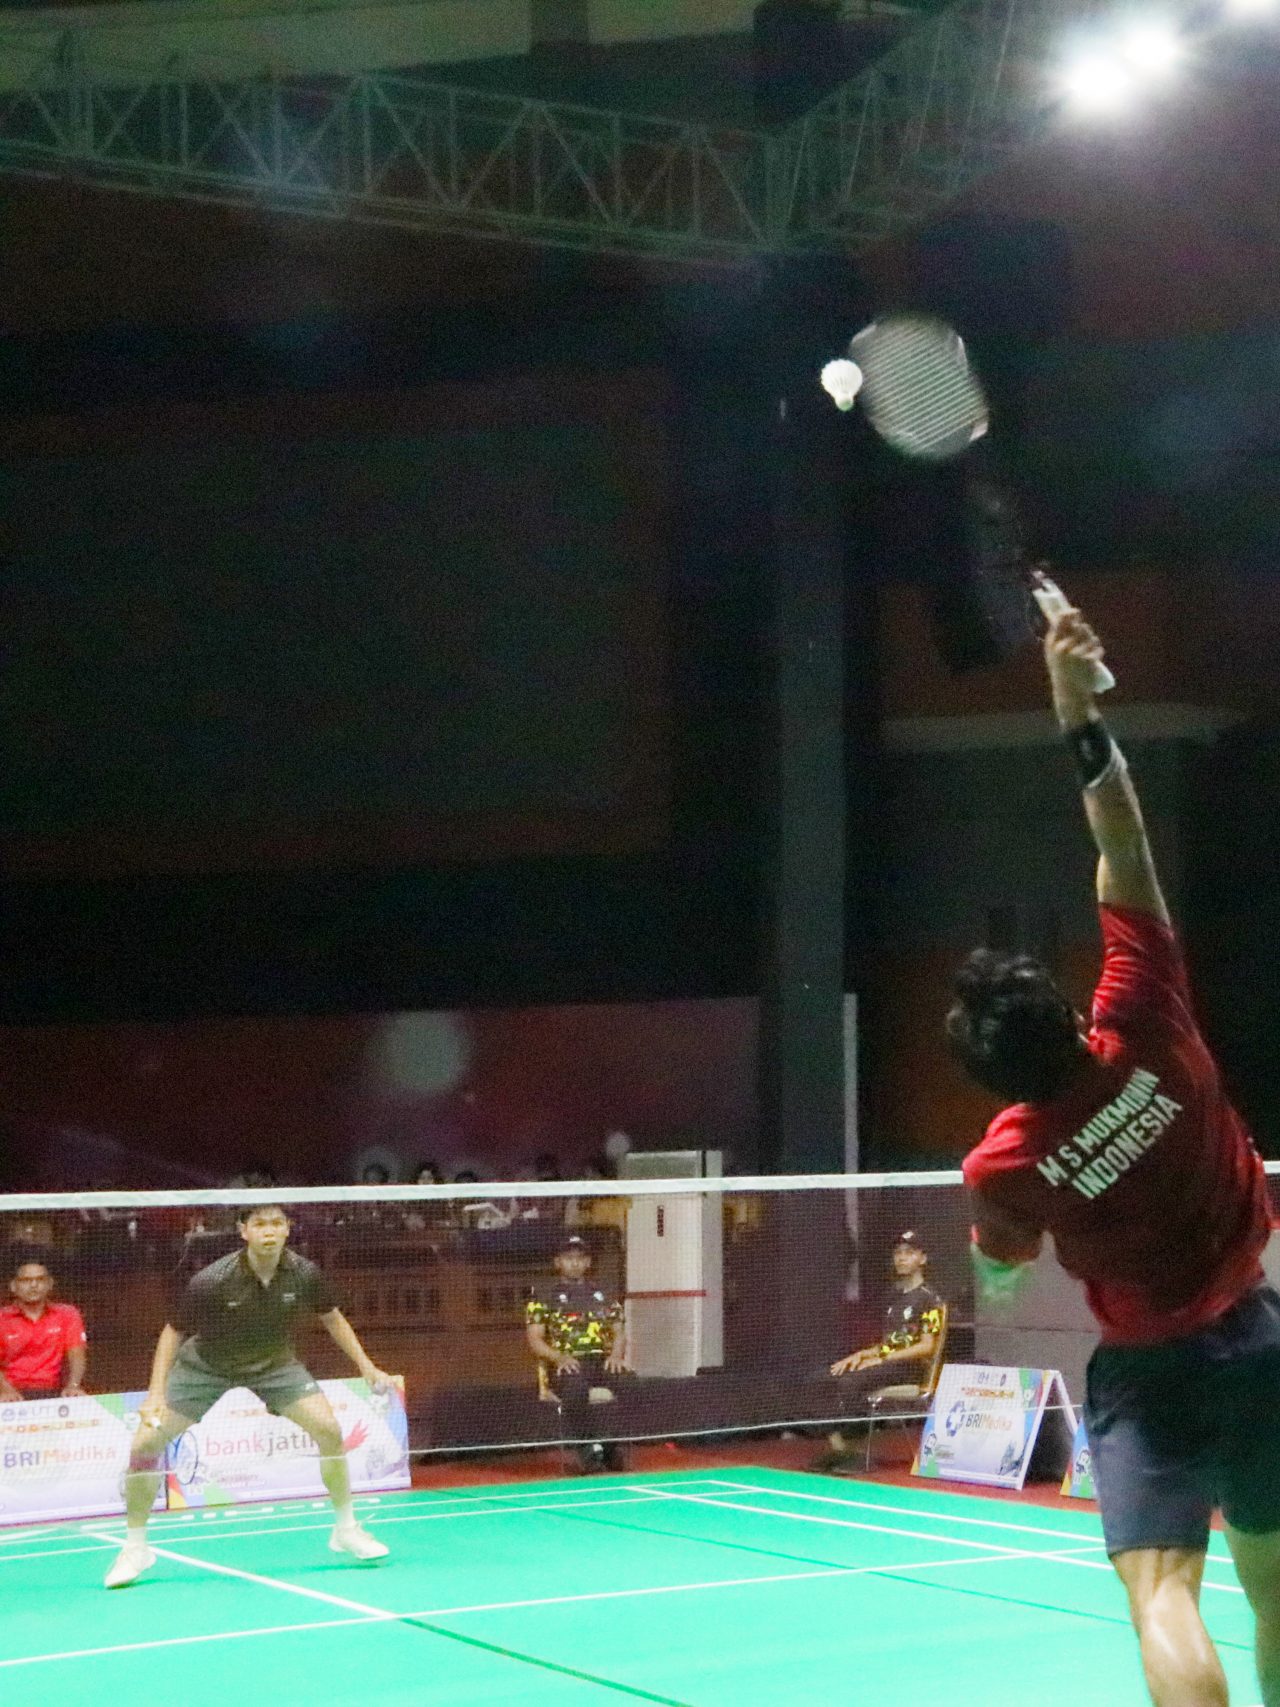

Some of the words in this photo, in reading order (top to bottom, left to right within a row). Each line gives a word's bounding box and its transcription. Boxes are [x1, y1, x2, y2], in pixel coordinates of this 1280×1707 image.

[1036, 1155, 1068, 1187] M
[1058, 1145, 1083, 1168] S
[1071, 1094, 1183, 1199] INDONESIA
